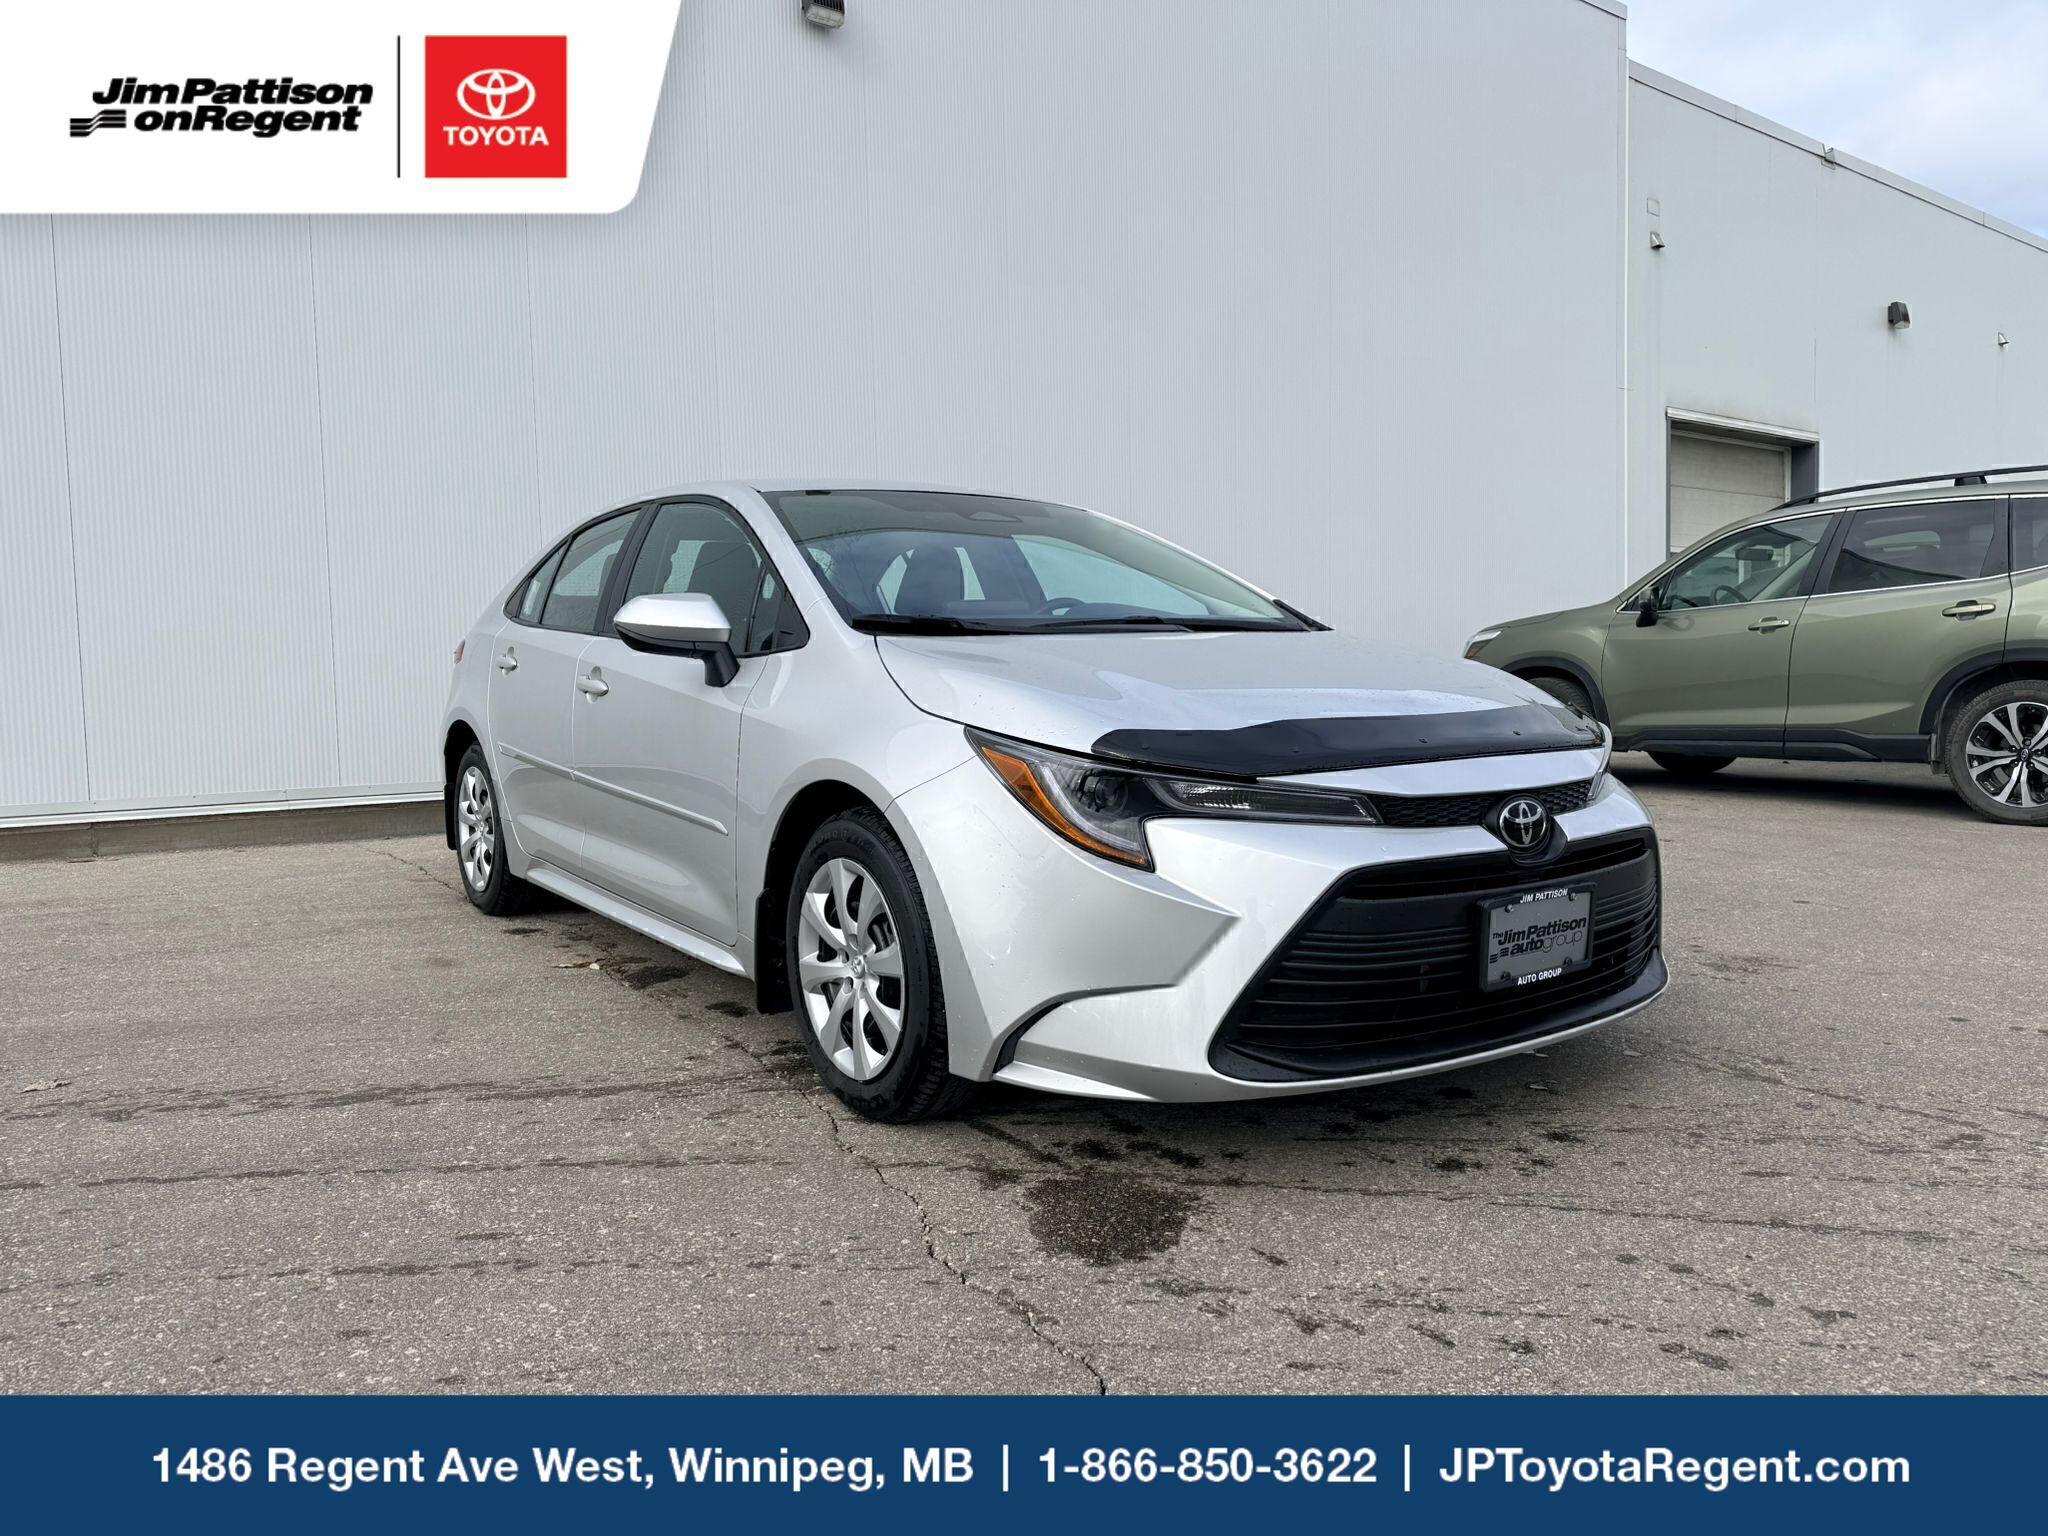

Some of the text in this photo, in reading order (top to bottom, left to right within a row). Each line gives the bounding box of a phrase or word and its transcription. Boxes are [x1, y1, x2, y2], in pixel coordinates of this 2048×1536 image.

[1520, 888, 1568, 903] JIM PATTISON
[1517, 967, 1562, 985] AUTO GROUP
